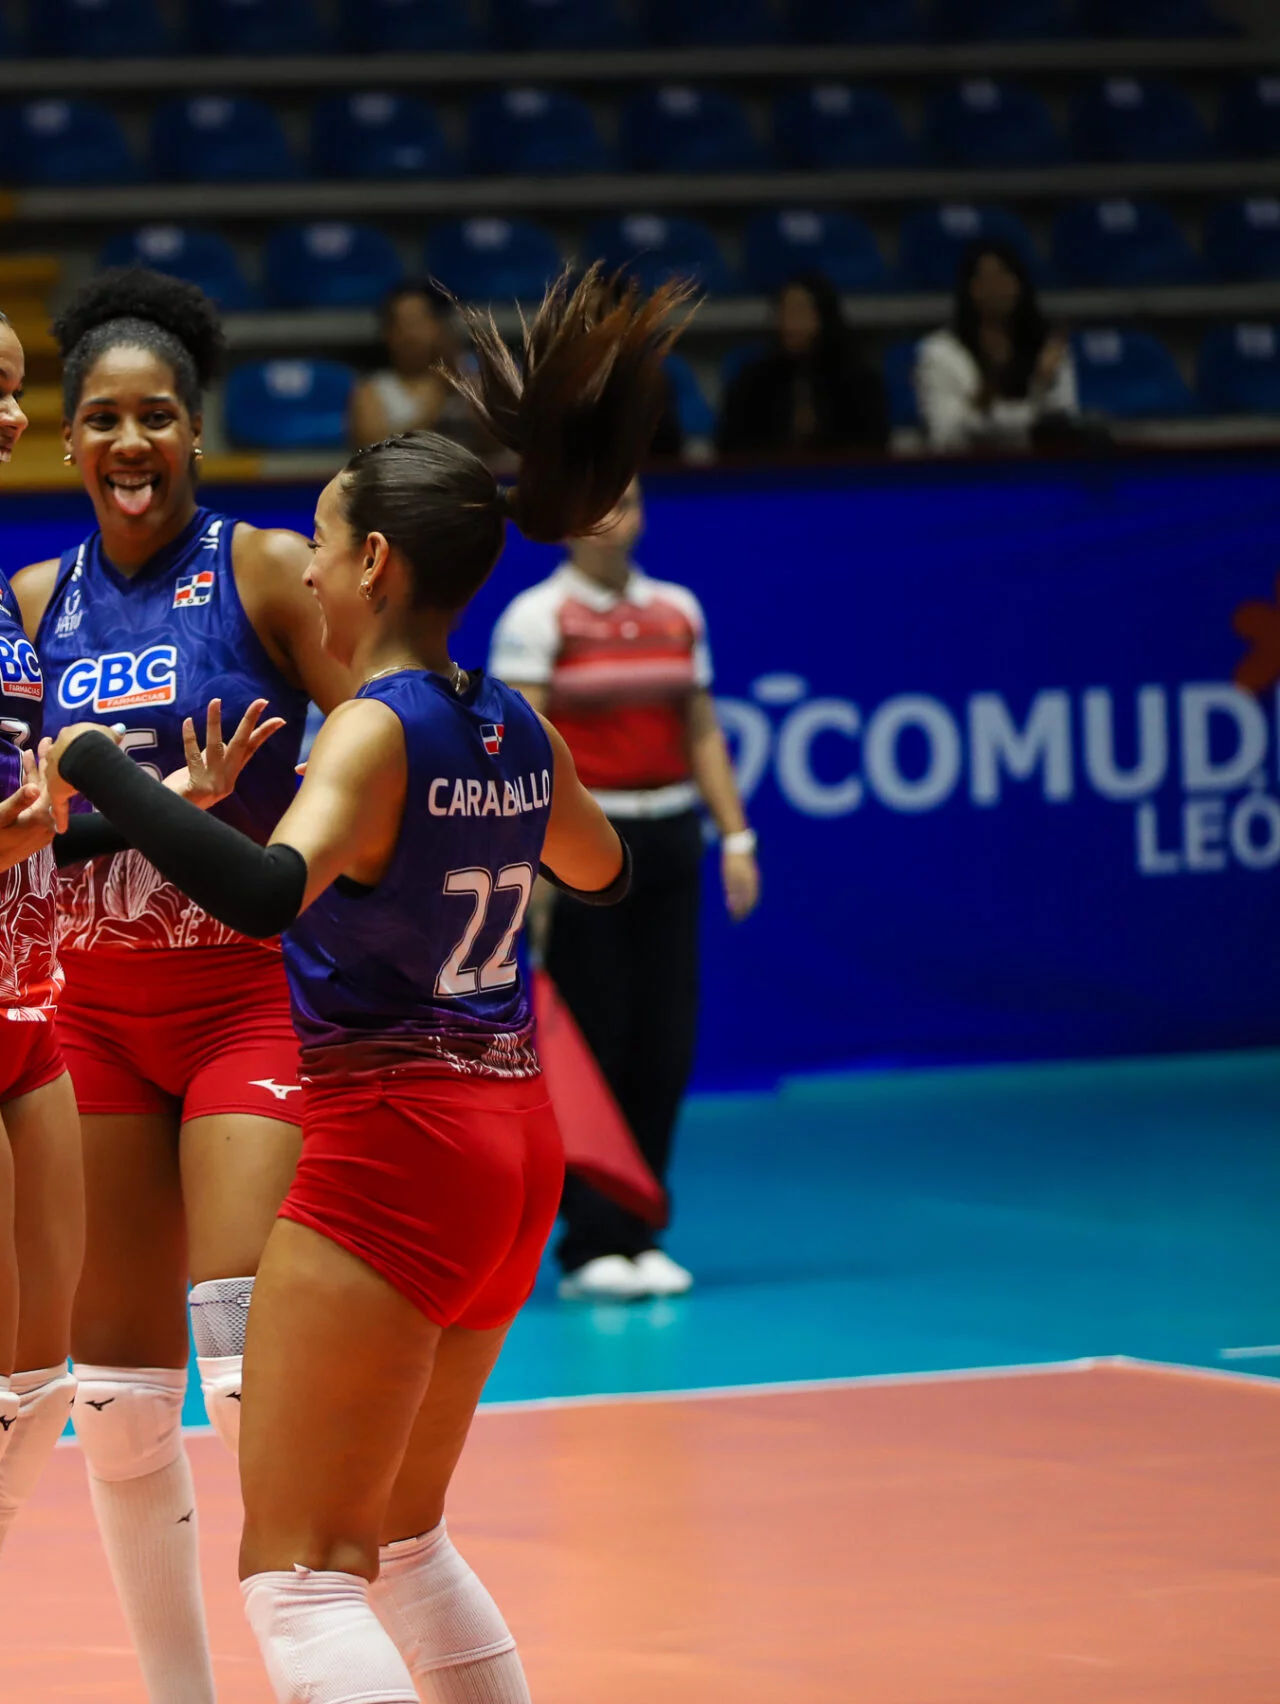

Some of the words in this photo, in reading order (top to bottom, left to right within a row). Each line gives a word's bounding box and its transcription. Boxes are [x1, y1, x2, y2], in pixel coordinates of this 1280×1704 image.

[58, 645, 177, 708] GBC
[106, 691, 167, 707] FARMACIAS
[433, 861, 534, 998] 22
